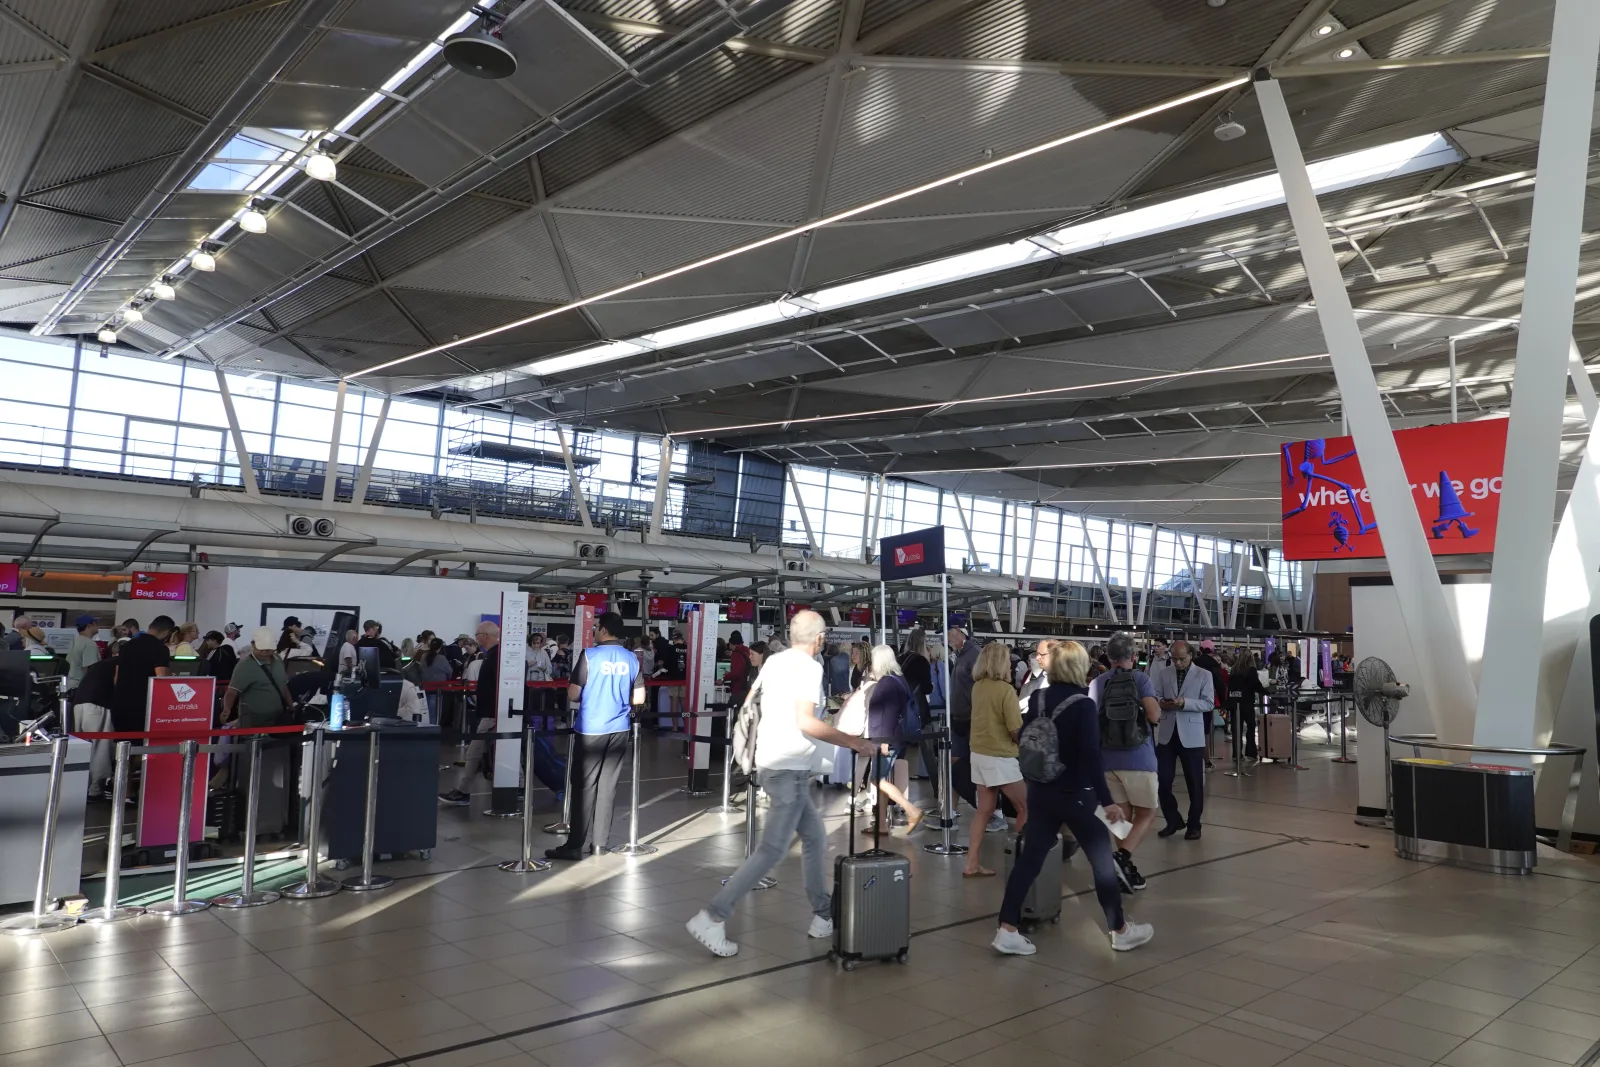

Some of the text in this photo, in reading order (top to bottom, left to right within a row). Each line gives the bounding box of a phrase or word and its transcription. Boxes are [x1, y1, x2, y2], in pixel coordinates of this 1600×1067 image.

[1299, 476, 1504, 507] wherer we go
[136, 589, 178, 599] Bag drop
[601, 661, 629, 676] SYD
[335, 702, 343, 725] SYD
